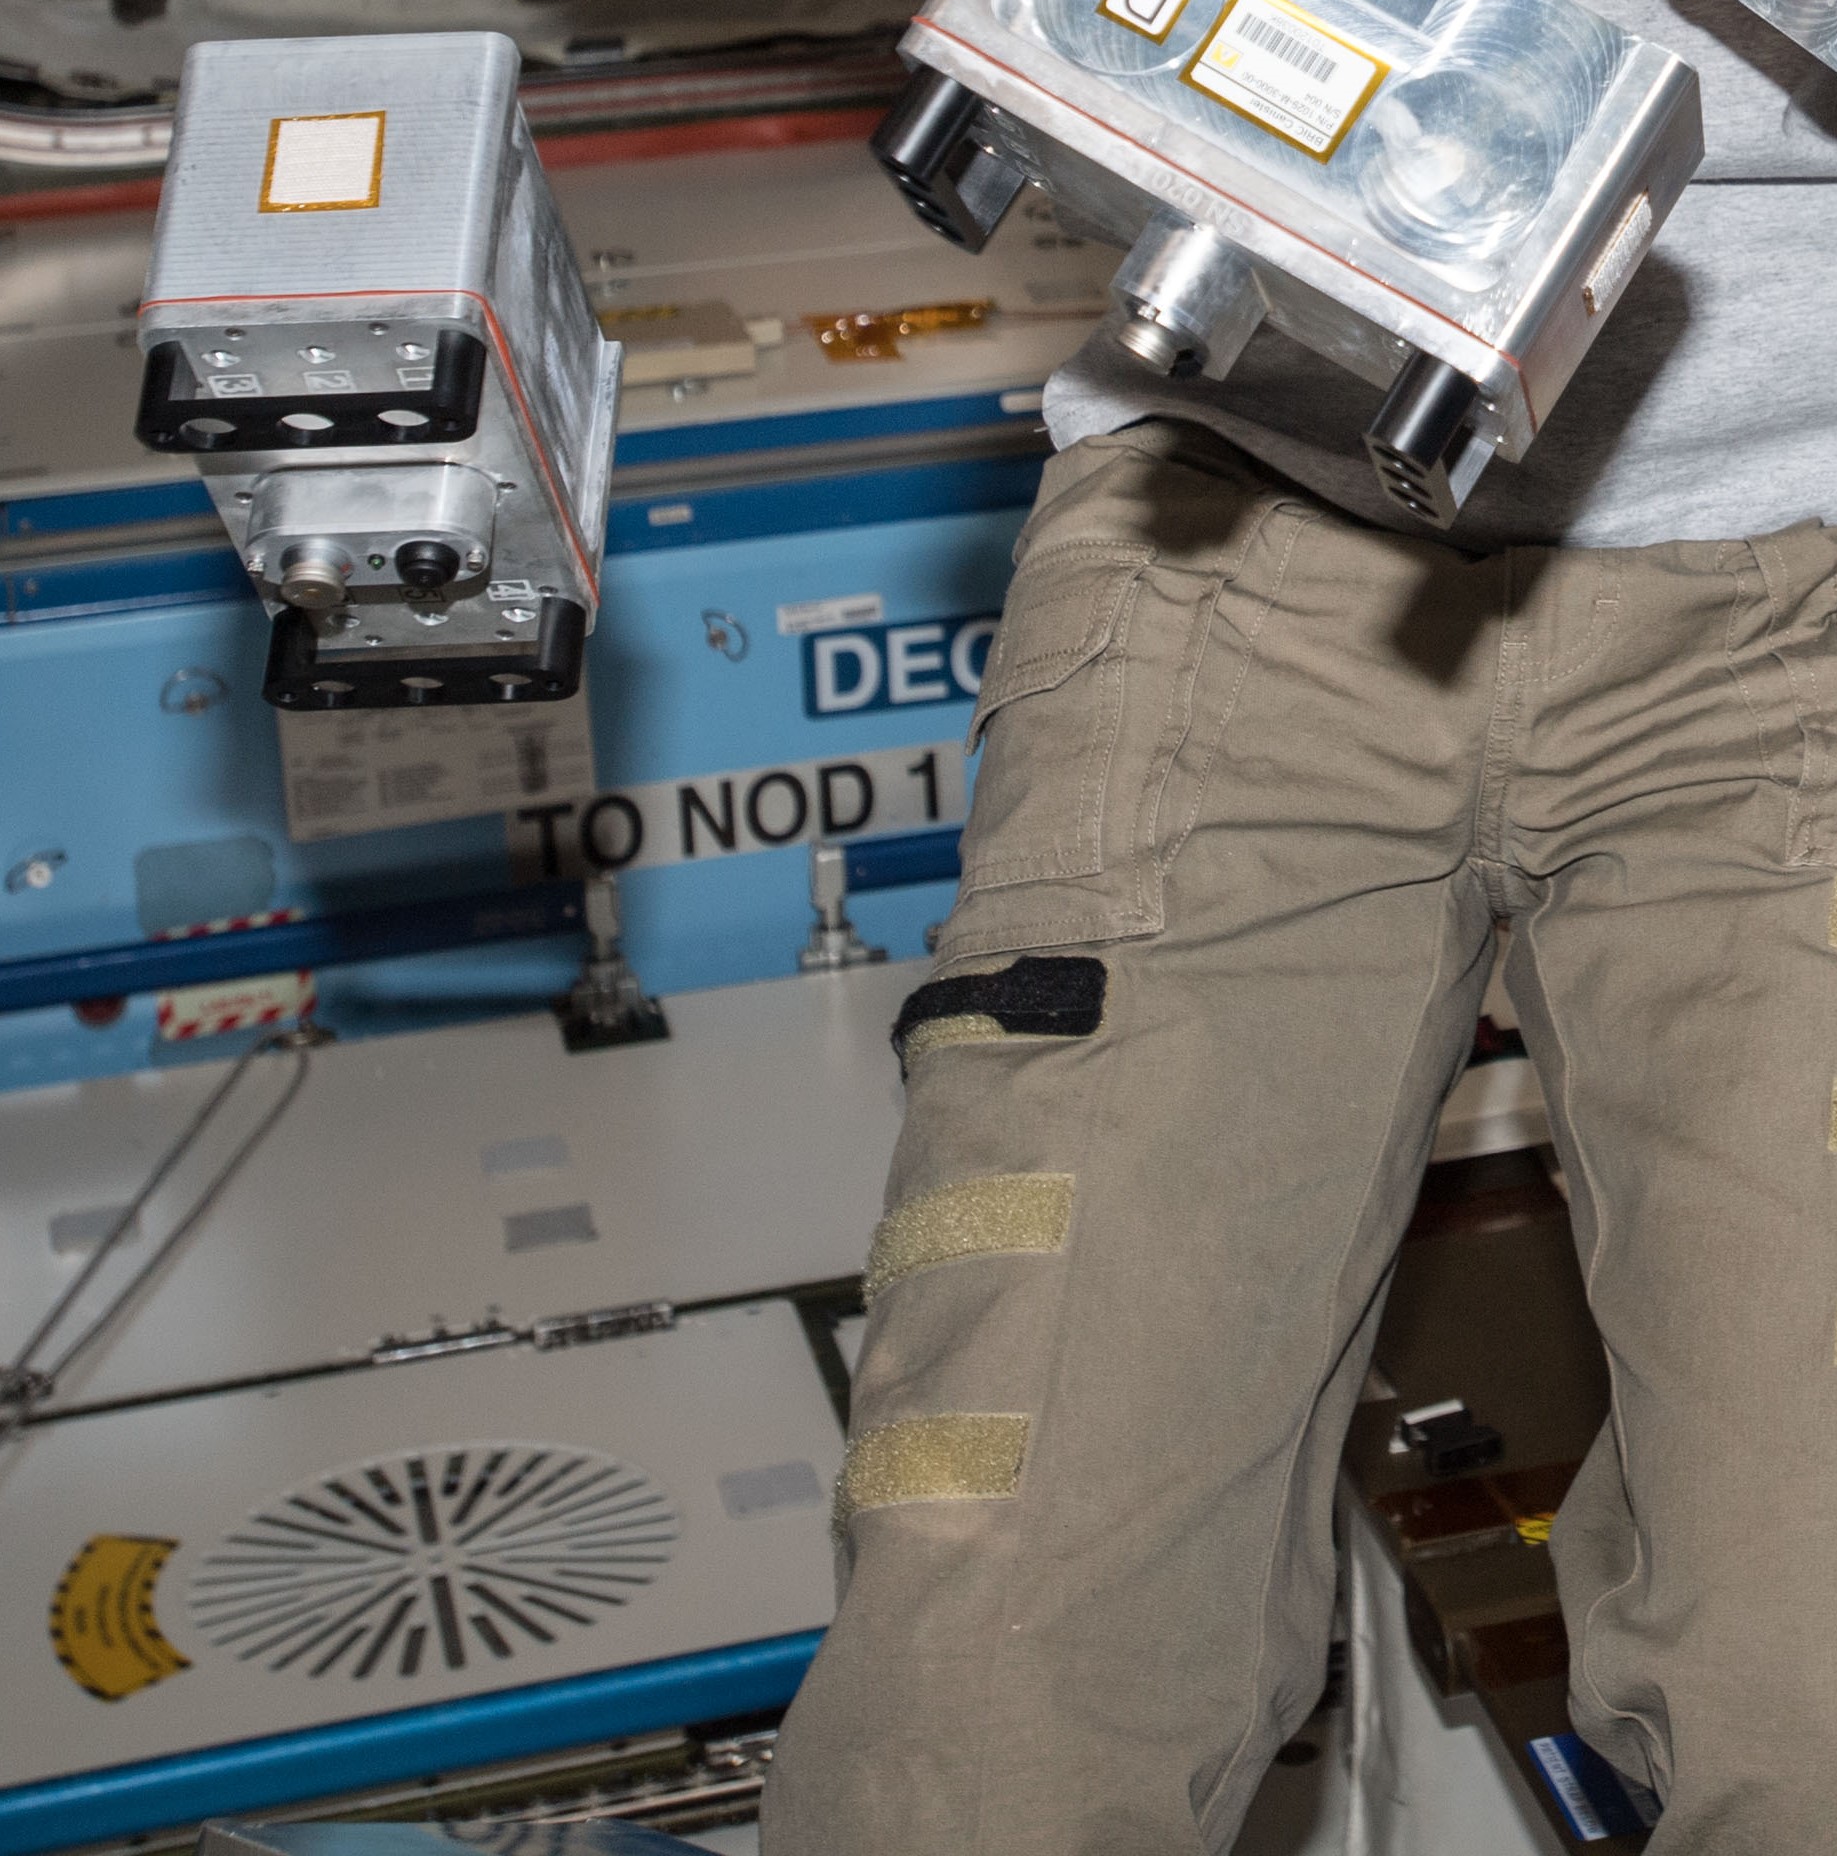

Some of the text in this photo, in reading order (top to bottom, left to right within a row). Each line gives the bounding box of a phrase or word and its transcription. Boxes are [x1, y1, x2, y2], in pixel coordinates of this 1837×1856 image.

[1250, 97, 1324, 147] BRIC Canister
[518, 793, 643, 877] TO
[678, 762, 875, 857] NOD
[907, 752, 940, 822] 1
